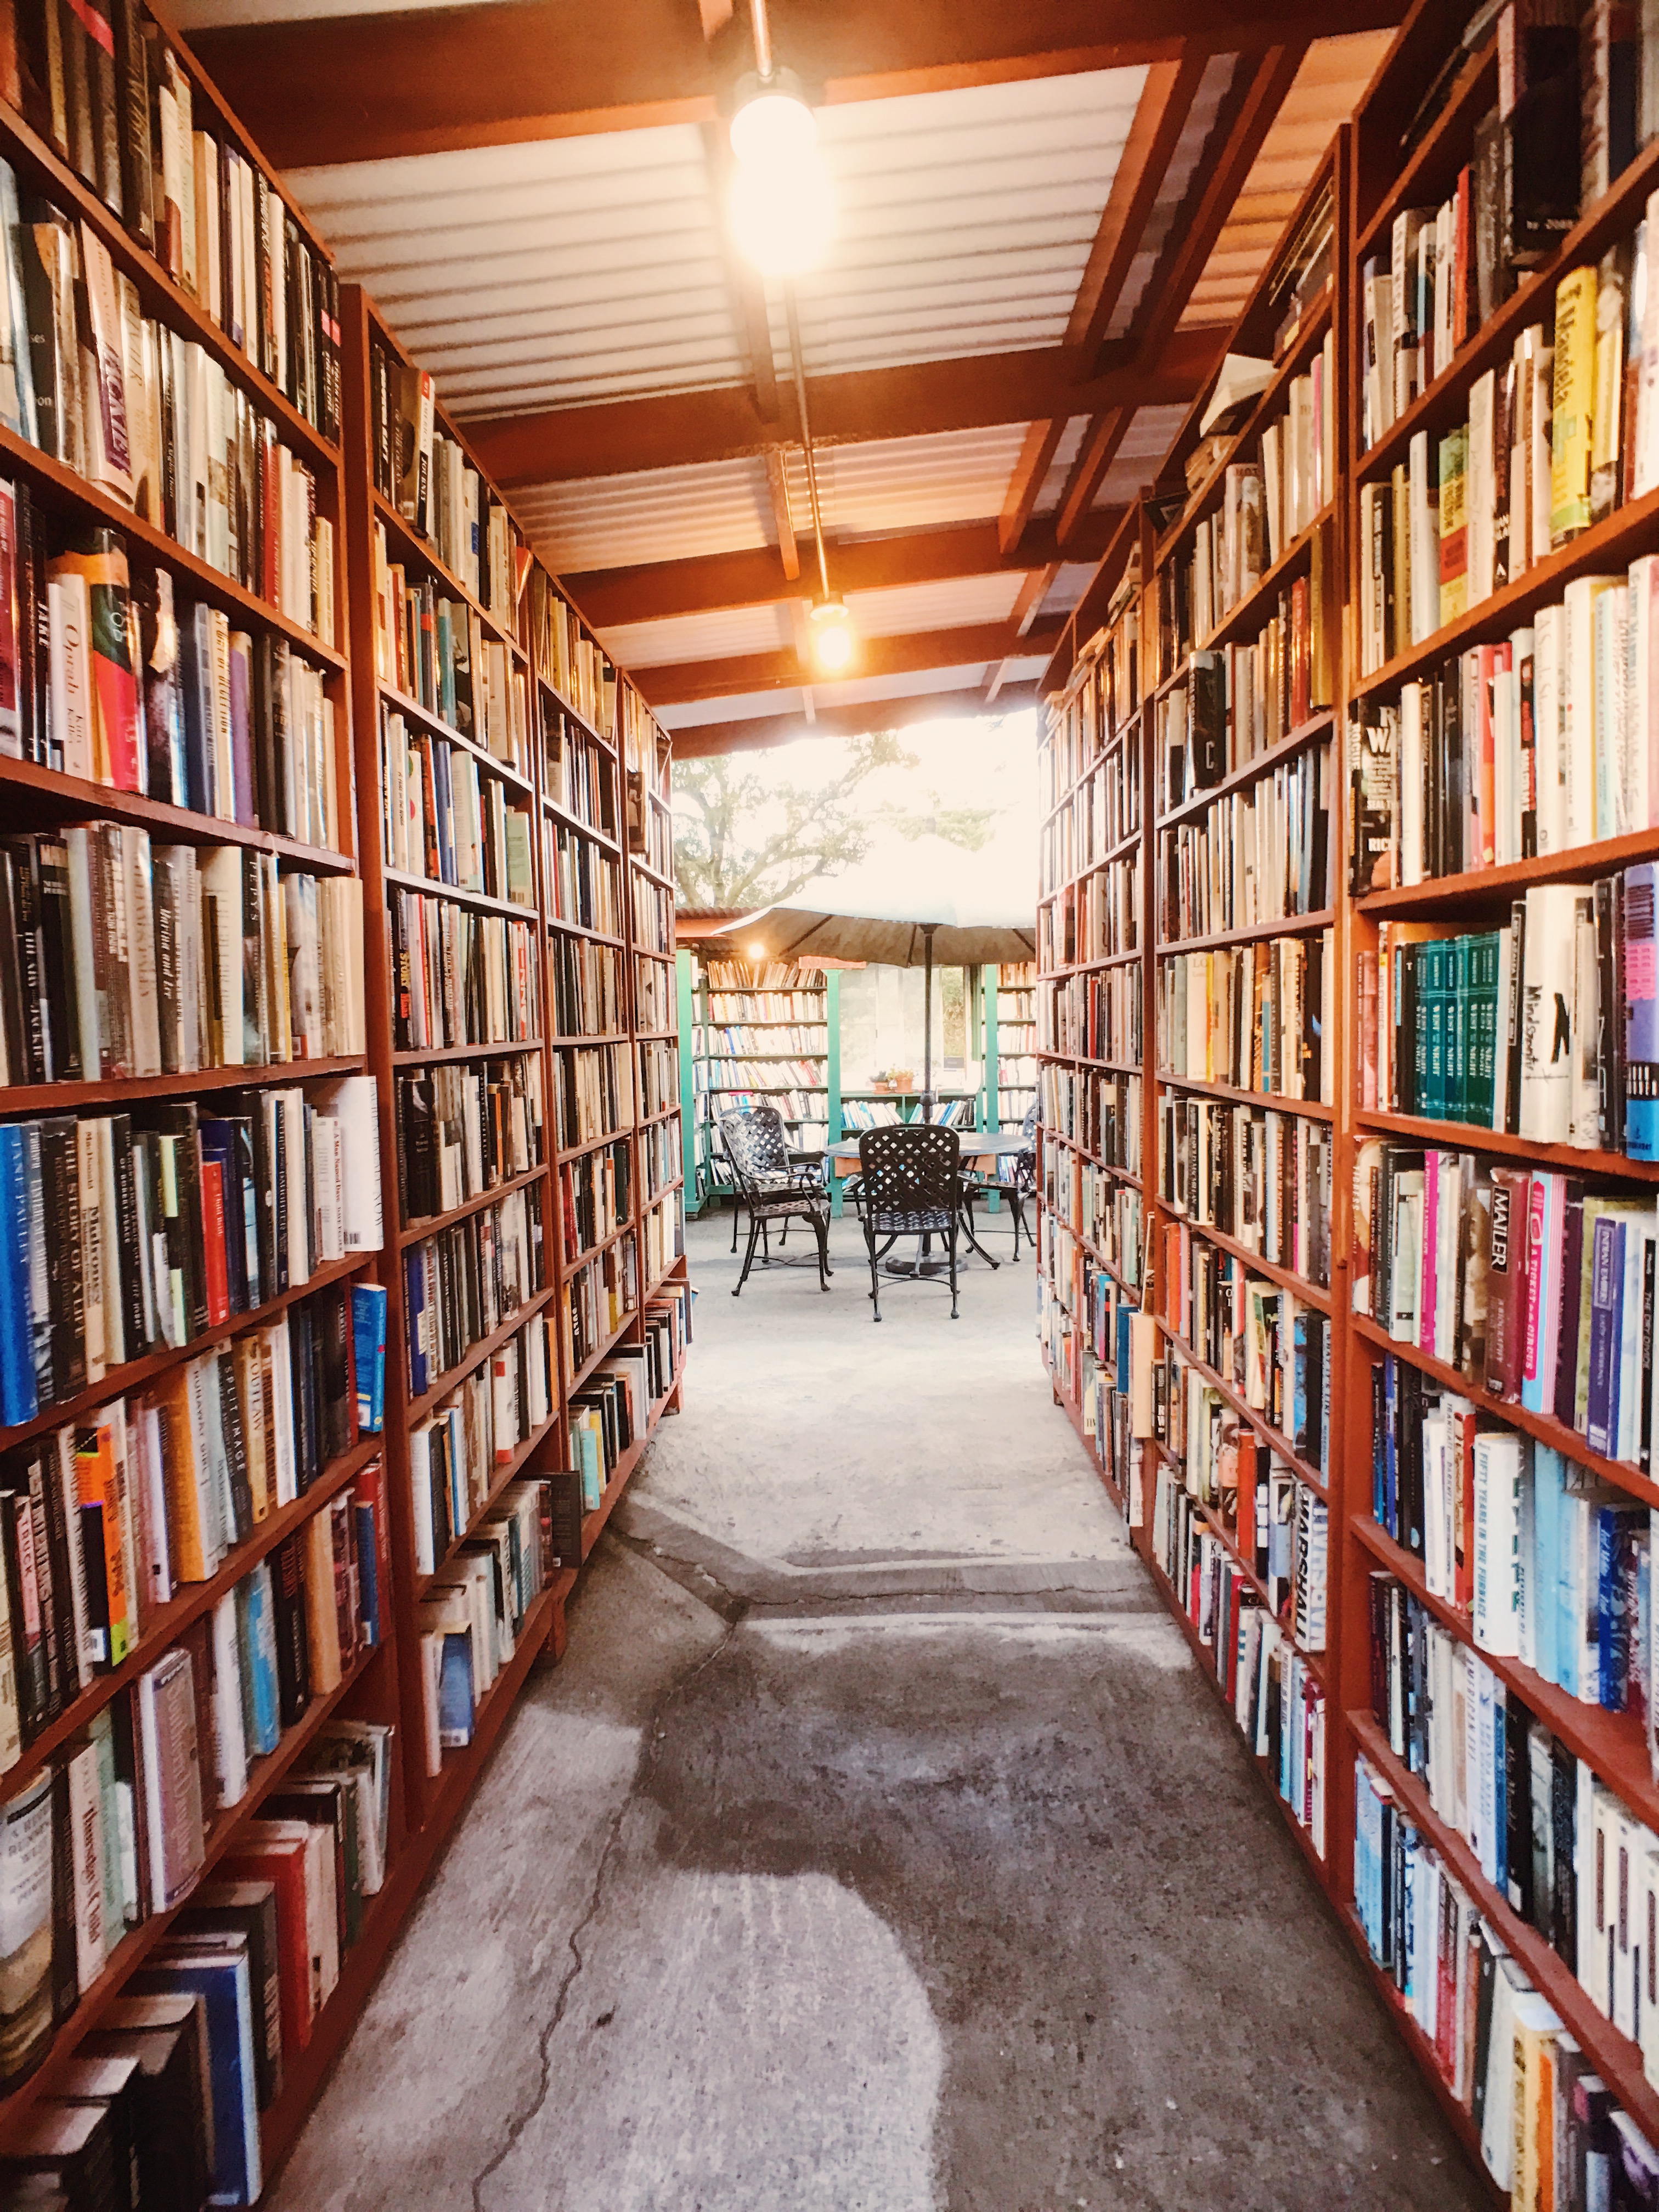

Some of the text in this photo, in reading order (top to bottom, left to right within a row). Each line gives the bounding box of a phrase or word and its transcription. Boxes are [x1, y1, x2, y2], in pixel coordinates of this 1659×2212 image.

[37, 600, 50, 650] JAKE
[62, 623, 81, 694] Oprah
[1350, 722, 1361, 771] ROGUE
[249, 860, 259, 923] PEPYS
[1627, 883, 1655, 941] BOTTOM
[159, 906, 175, 1000] Marina and Lee
[398, 952, 411, 989] STORY
[1432, 1045, 1440, 1077] NIGHT
[12, 1142, 28, 1263] JANE PAULEY
[120, 1174, 128, 1210] ROBERT
[215, 1193, 224, 1238] Child Bride
[279, 1170, 288, 1231] DAUGHTER
[65, 1138, 86, 1339] THE STORY OF A LIFE
[122, 1213, 131, 1244] PEACE
[1491, 1192, 1509, 1267] MAILER
[1528, 1260, 1538, 1303] TICKET
[1525, 1324, 1535, 1369] CIRCUS
[1642, 1292, 1652, 1369] THE DRY DIVIDE
[224, 1365, 246, 1472] SPLIT IMAGE
[251, 1362, 262, 1431] OUTLAW
[21, 1519, 33, 1578] TRUCK
[1477, 1453, 1488, 1619] FIFTY YEARS IN THE FURNACE
[166, 1680, 193, 1870] Southern Daughter
